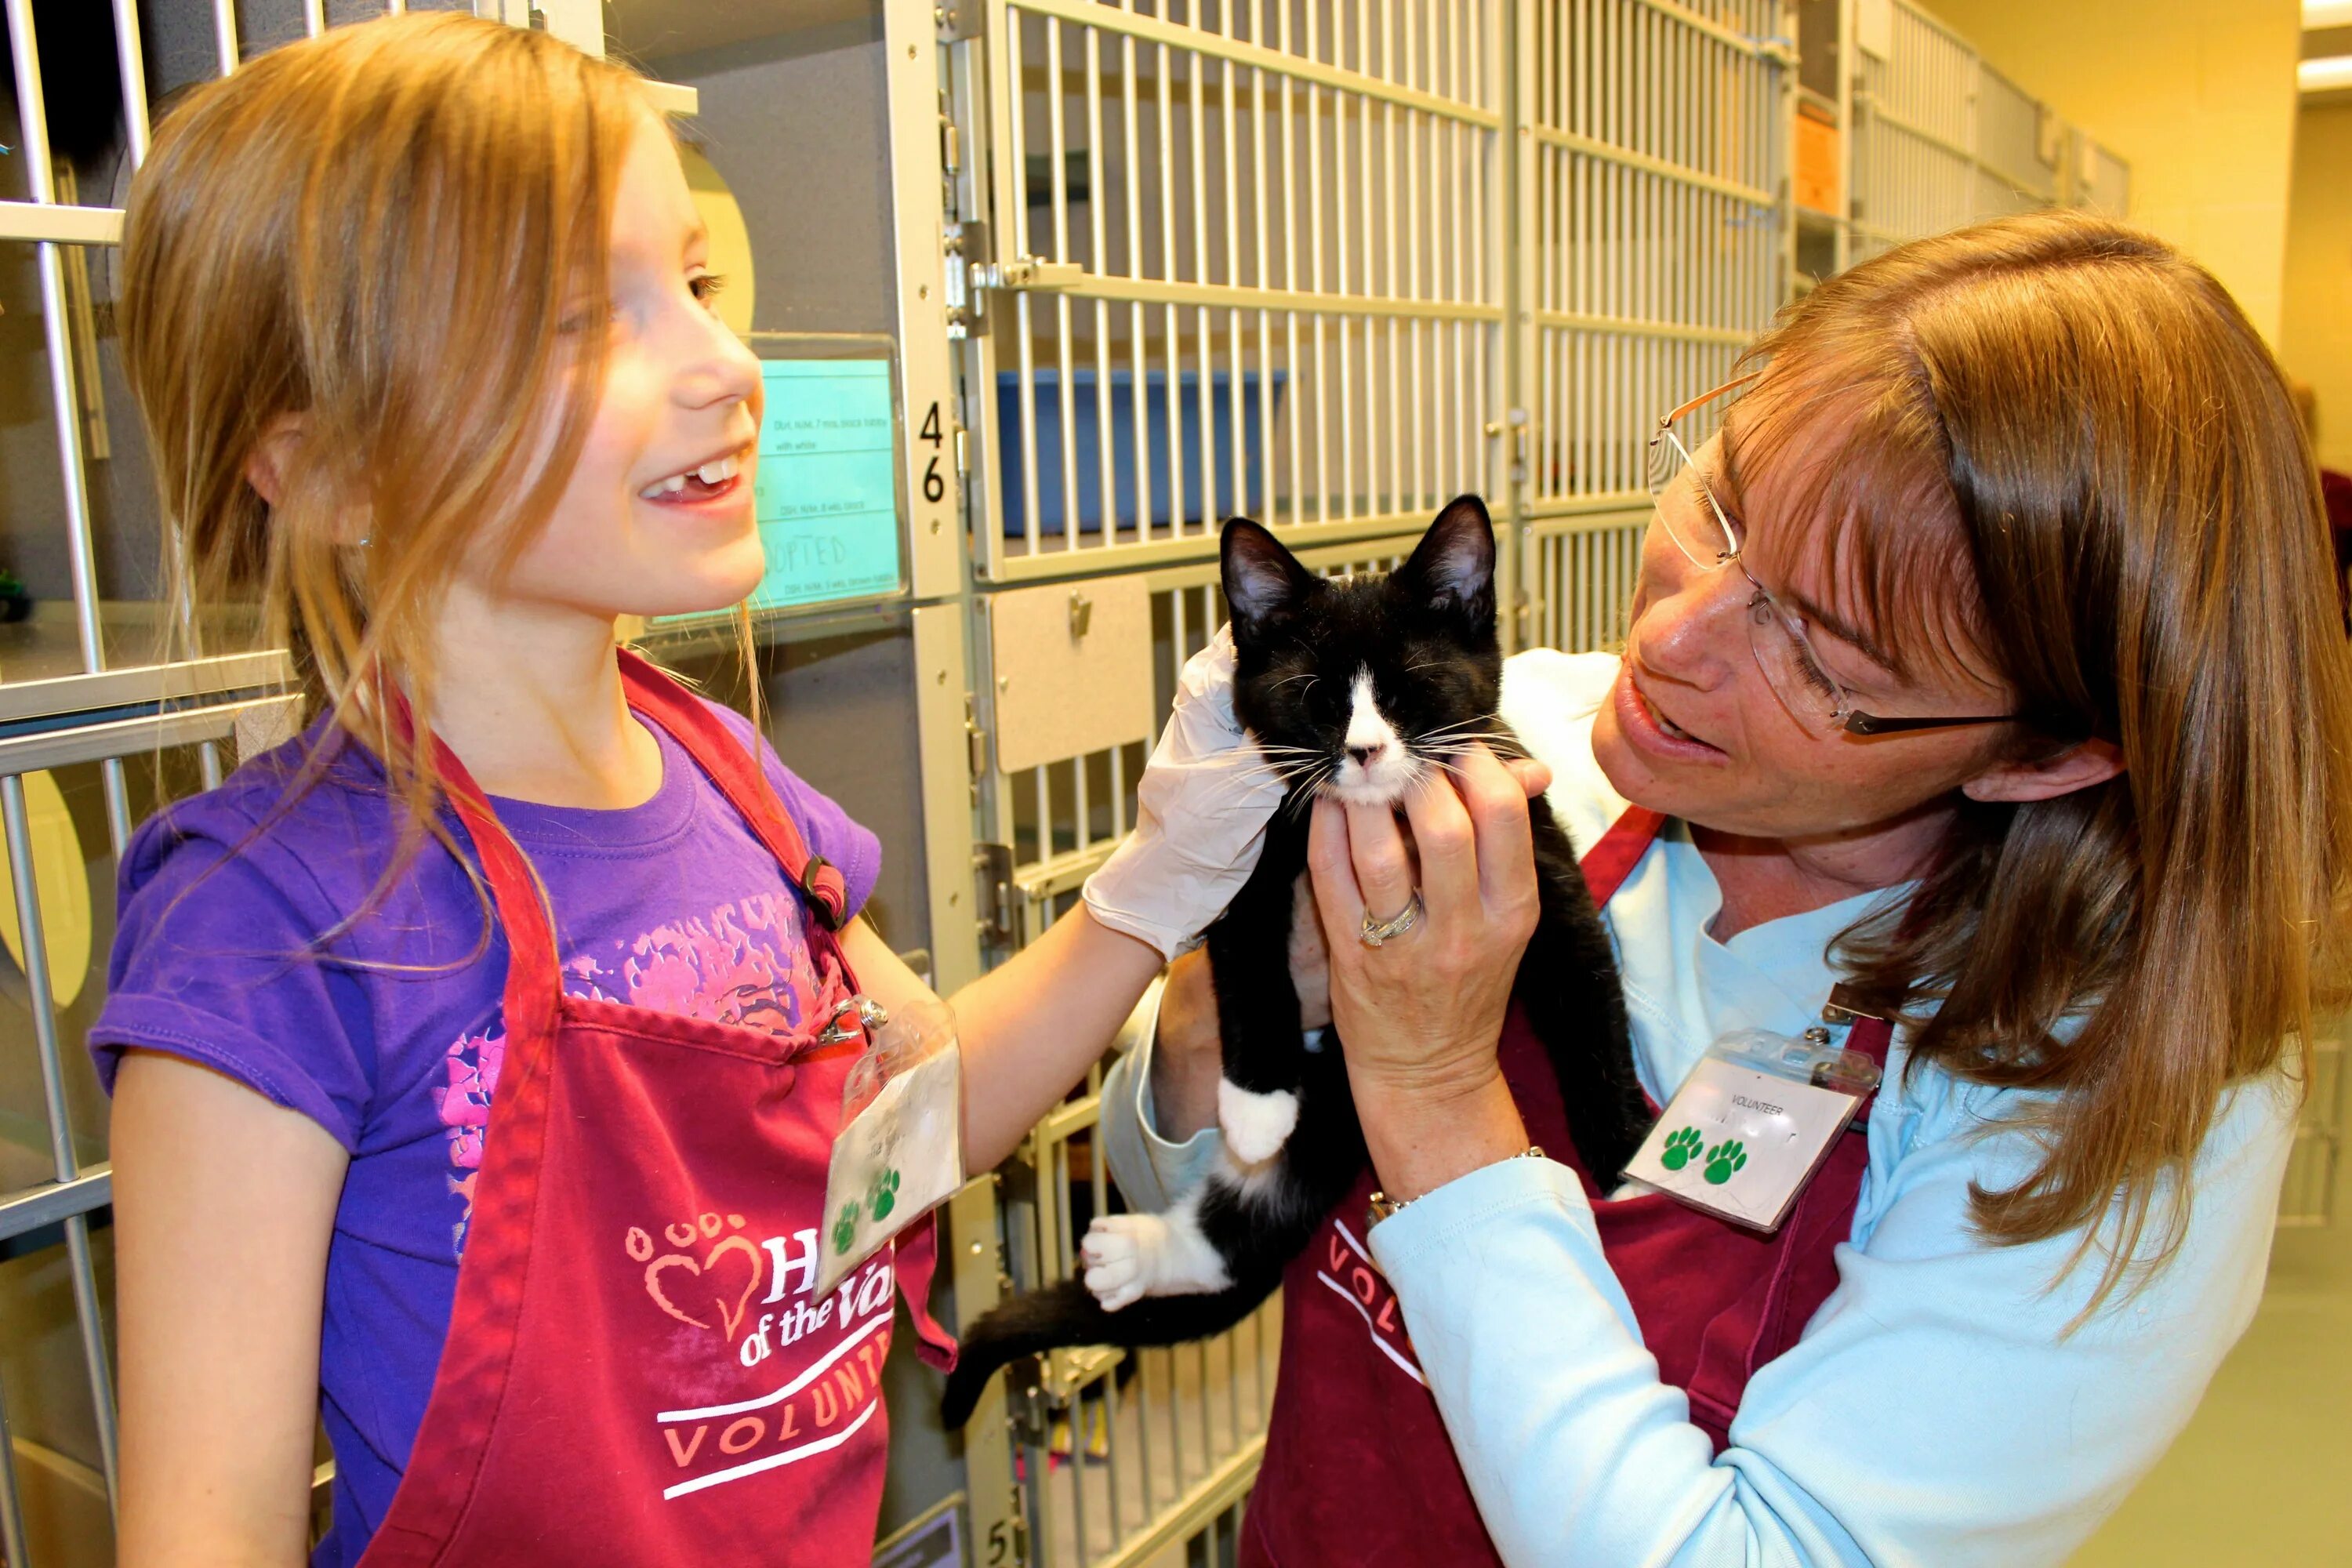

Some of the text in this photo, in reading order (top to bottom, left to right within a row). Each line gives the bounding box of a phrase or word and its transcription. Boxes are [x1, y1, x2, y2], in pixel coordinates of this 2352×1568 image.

[1732, 1094, 1784, 1116] VOLUNTEER
[761, 1228, 818, 1304] H
[1330, 1235, 1399, 1333] VOL
[740, 1314, 772, 1367] of
[779, 1300, 830, 1347] the
